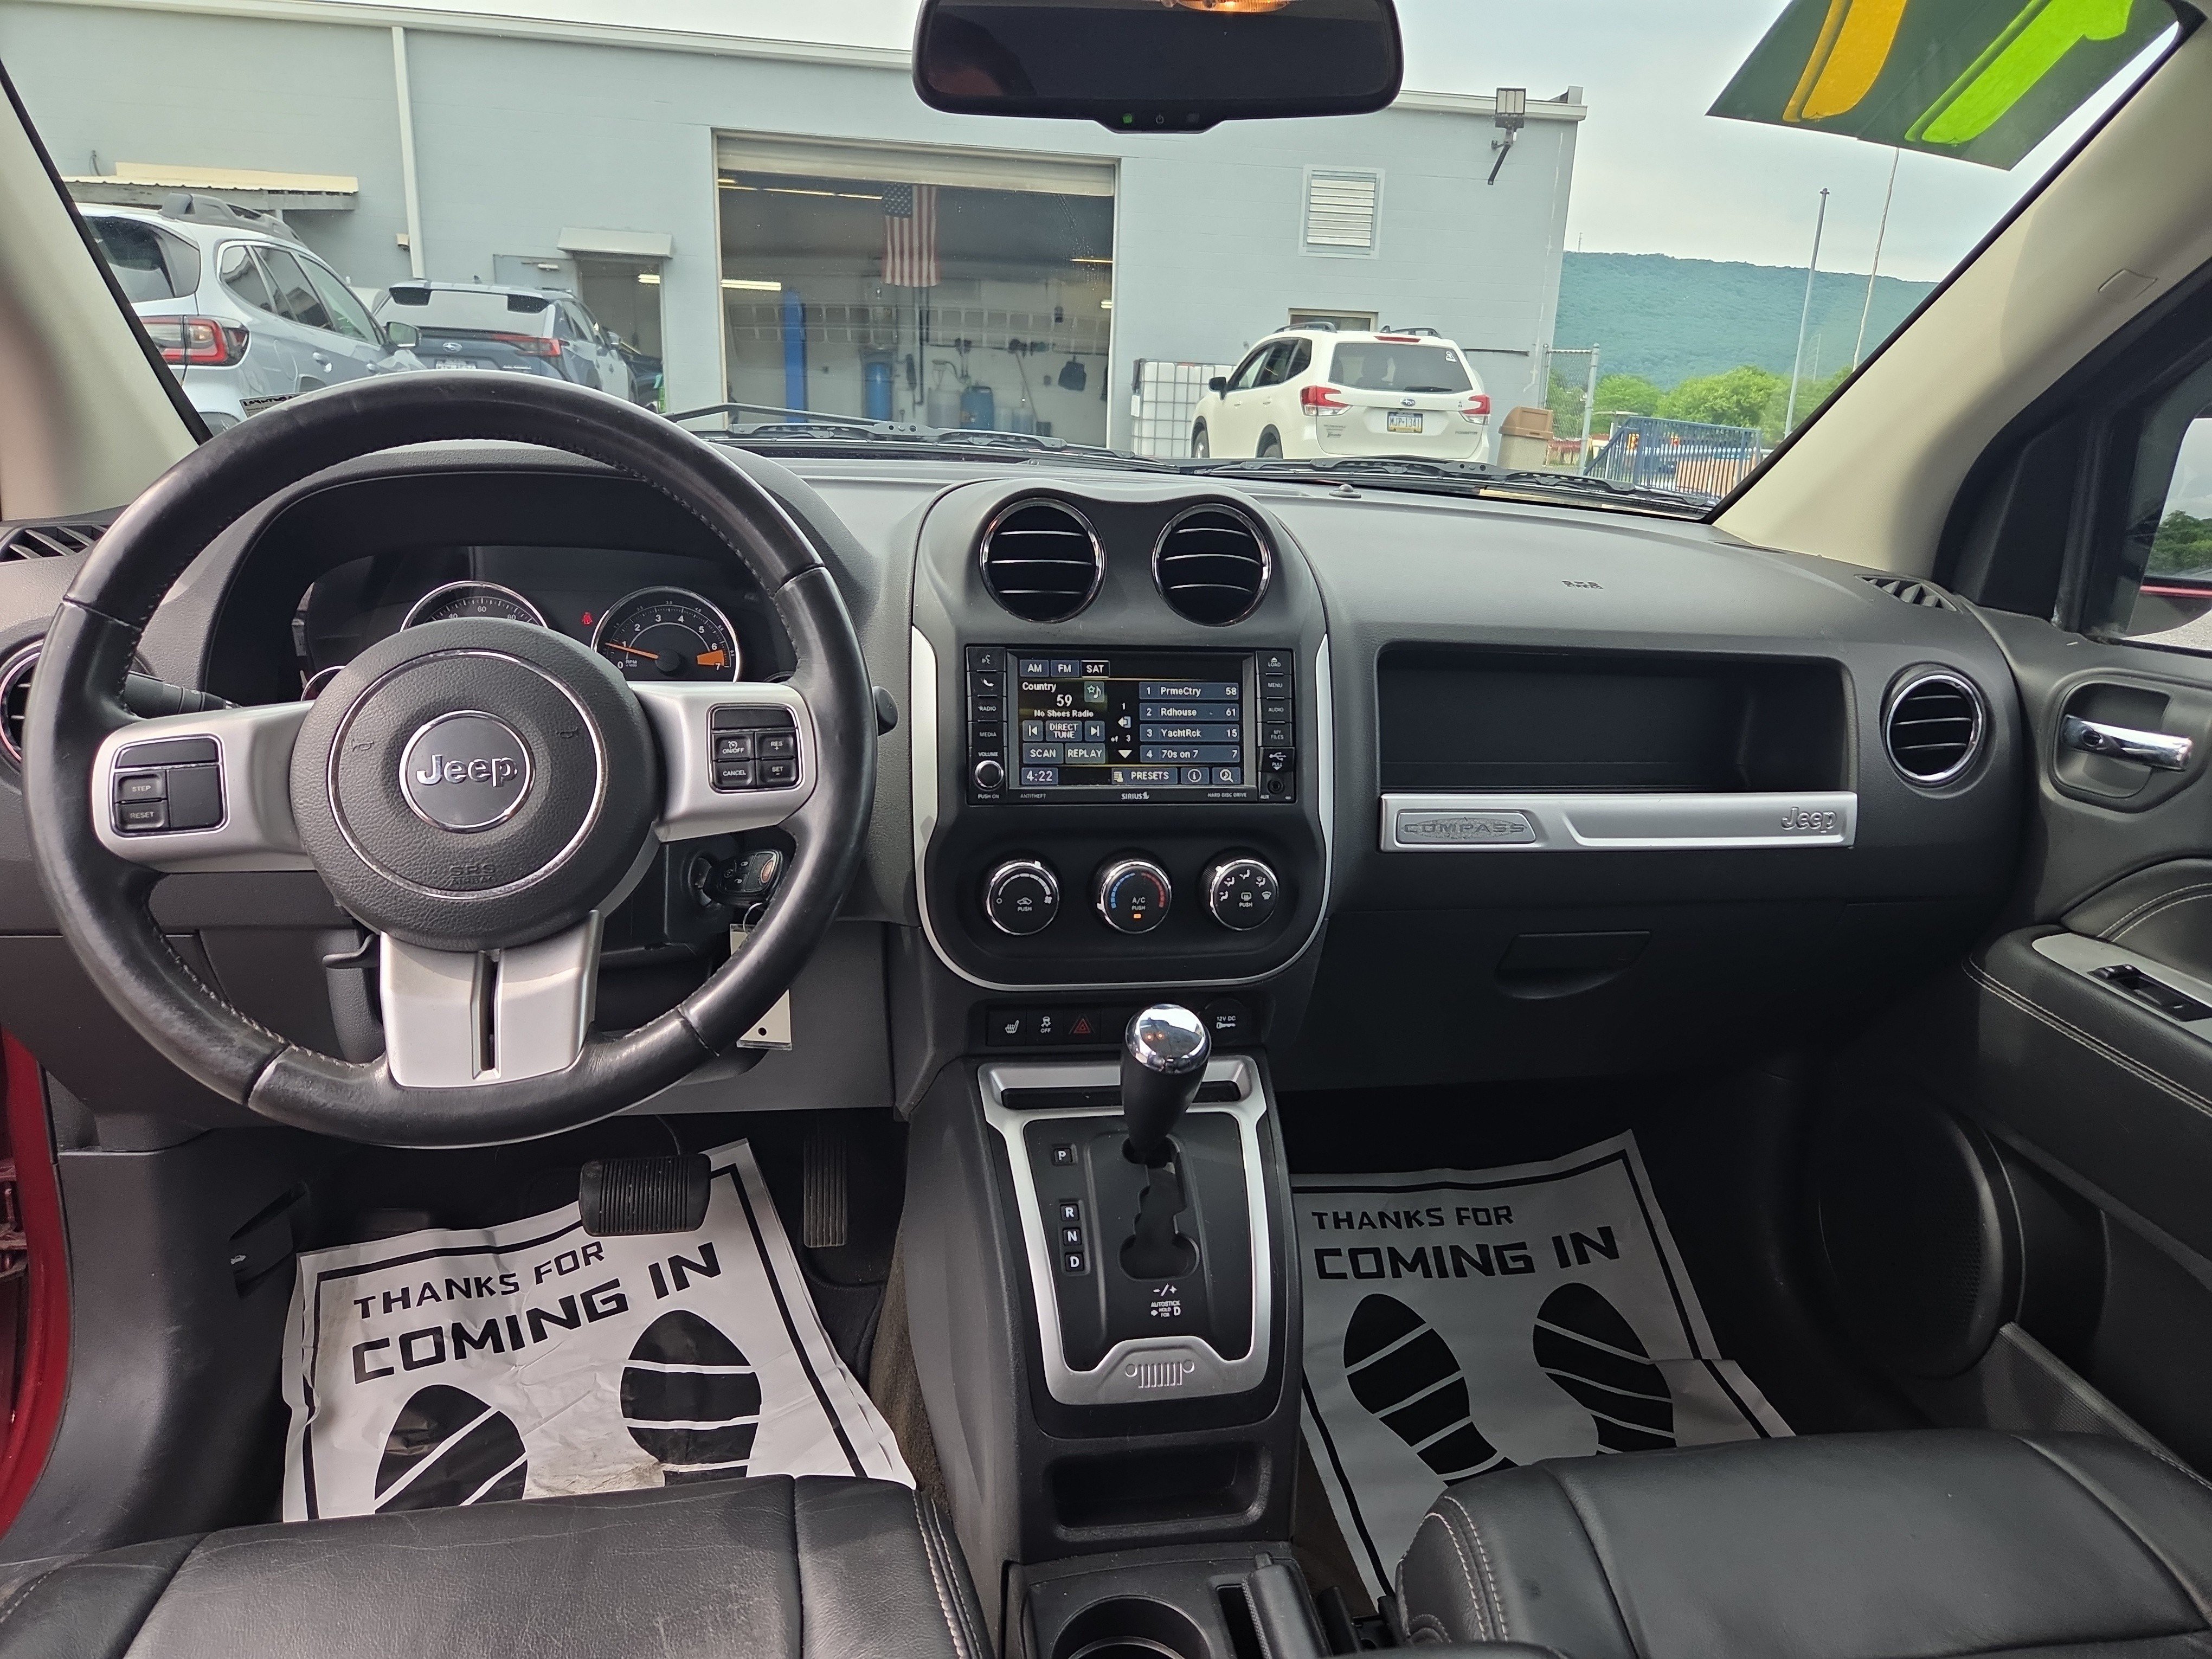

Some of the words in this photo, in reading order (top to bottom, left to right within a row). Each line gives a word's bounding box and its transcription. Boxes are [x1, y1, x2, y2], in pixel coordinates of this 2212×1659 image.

[655, 614, 661, 622] 3
[635, 623, 640, 632] 2
[618, 661, 623, 669] 0
[1027, 664, 1042, 673] AM
[1058, 664, 1071, 673] FM
[1086, 664, 1104, 673] SAT
[1022, 682, 1056, 693] Country
[1160, 687, 1201, 697] PrmeCtry
[1226, 687, 1237, 696] 58
[1057, 695, 1072, 706] 59
[1161, 708, 1197, 716] Rdhouse
[1226, 708, 1236, 716] 61
[1050, 723, 1078, 731] DIRECT
[1161, 729, 1201, 738] YachtRck
[1226, 729, 1238, 737] 15
[1030, 749, 1056, 757] SCAN
[1068, 749, 1102, 757] REPLAY
[1146, 750, 1153, 758] 4
[1161, 750, 1178, 758] 70s
[1192, 750, 1199, 758] 7
[1232, 750, 1238, 758] 7
[416, 754, 518, 787] Jeep
[1026, 770, 1053, 781] 4:22
[1131, 771, 1169, 780] PRESETS
[1781, 806, 1837, 833] Jeep
[1404, 824, 1528, 833] COMPASS
[1058, 1150, 1066, 1160] P
[1065, 1207, 1073, 1217] R
[1311, 1206, 1445, 1230] THANKS
[1456, 1206, 1514, 1226] FOR
[1068, 1231, 1077, 1242] N
[1314, 1243, 1535, 1279] COMING
[1551, 1226, 1620, 1269] IN
[1070, 1257, 1079, 1267] D
[353, 1271, 519, 1319] THANKS
[534, 1242, 605, 1284] FOR
[352, 1278, 629, 1384] COMING
[648, 1242, 723, 1299] IN
[1174, 1306, 1181, 1316] D
